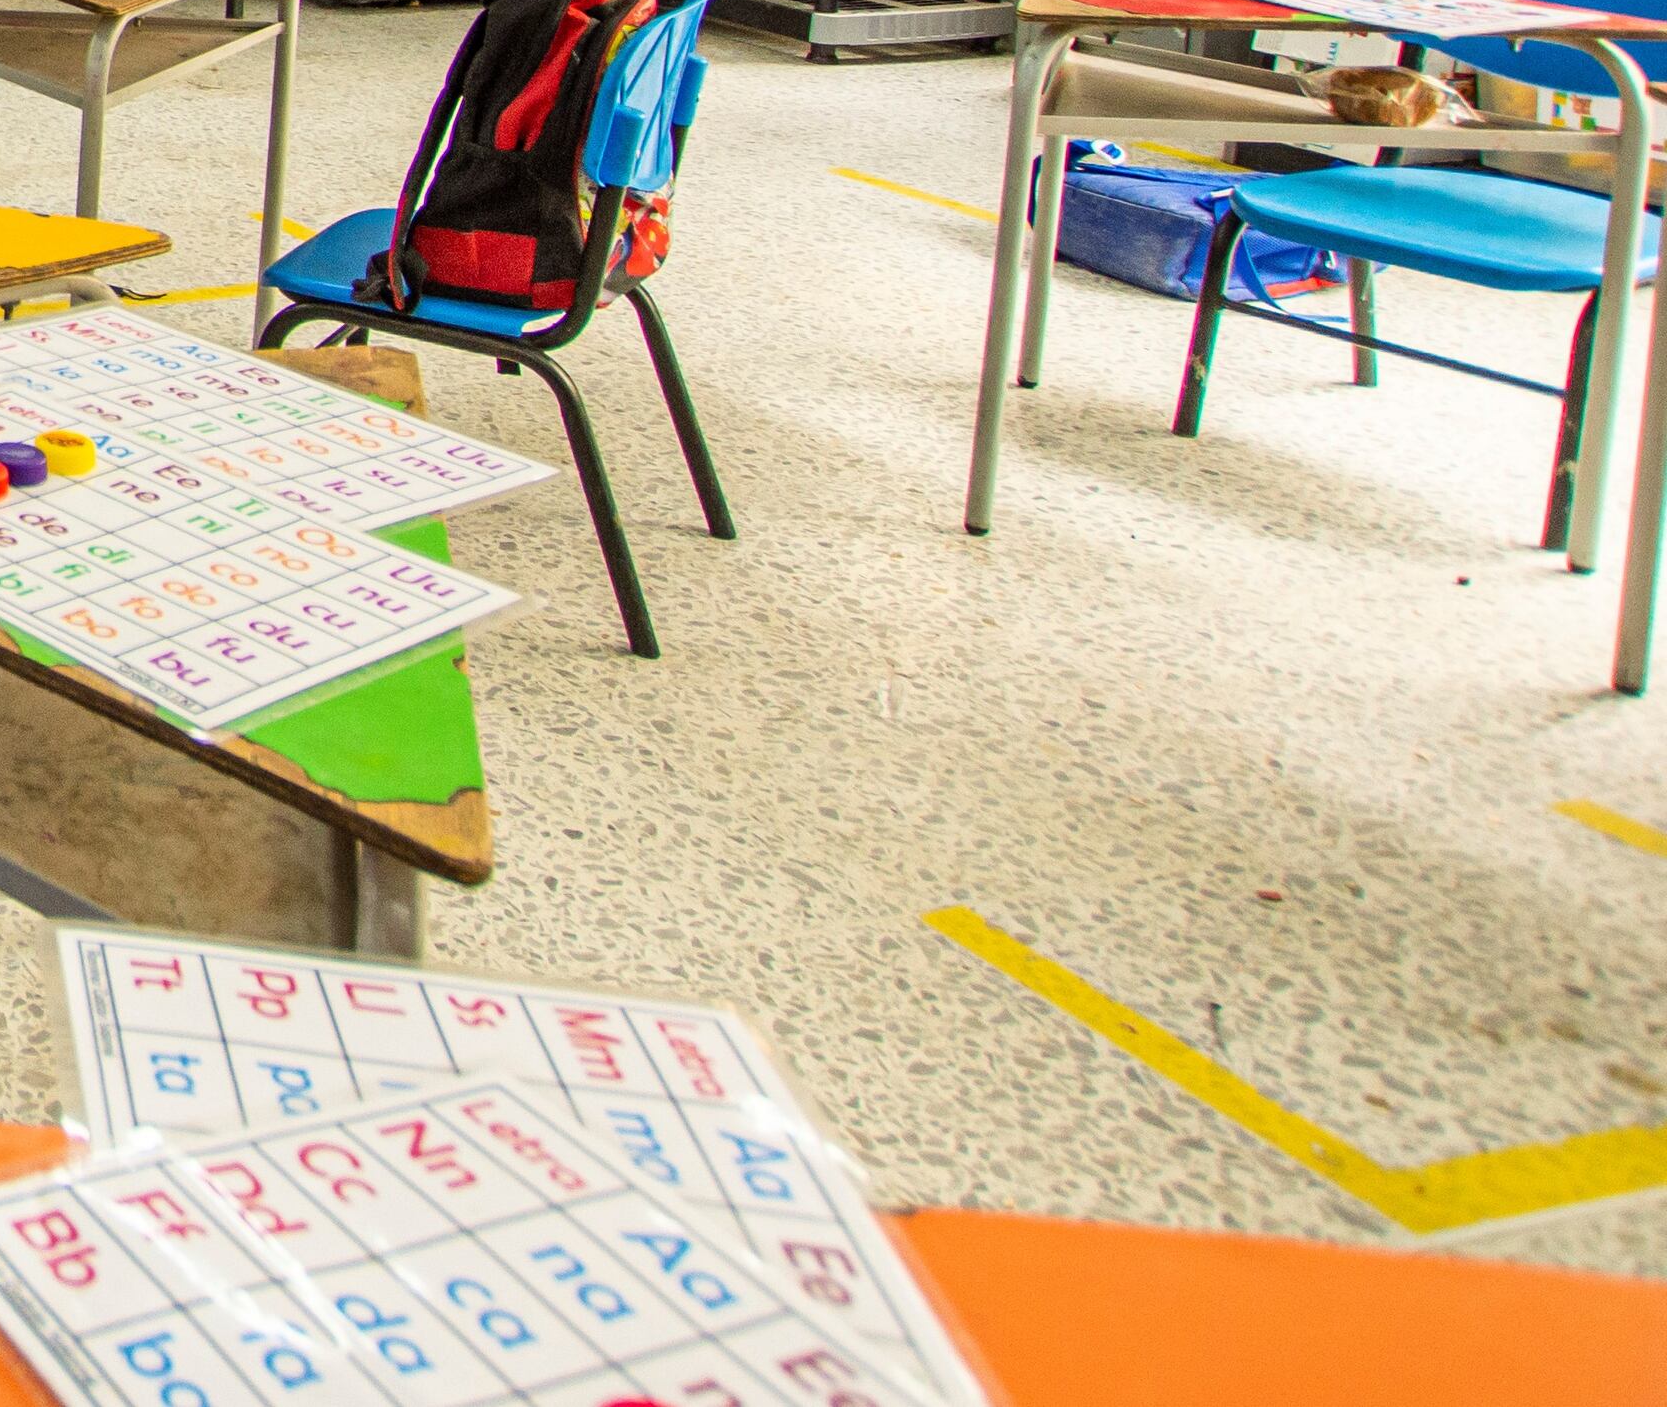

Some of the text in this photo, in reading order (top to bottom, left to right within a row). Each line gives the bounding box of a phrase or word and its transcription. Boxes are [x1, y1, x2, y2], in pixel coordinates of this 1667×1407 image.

[195, 374, 249, 396] me
[153, 464, 202, 490] Ee
[401, 453, 466, 483] mu
[109, 479, 160, 504] ne
[254, 544, 311, 573] no
[296, 528, 356, 558] Oo
[210, 563, 258, 586] co
[389, 565, 457, 599] Uu
[248, 619, 313, 651] du
[149, 651, 211, 688] bu
[131, 958, 183, 991] Tt
[238, 968, 297, 1020] Pp
[461, 1101, 586, 1191] Letra
[13, 1211, 97, 1288] Bb
[529, 1245, 635, 1322] na
[622, 1231, 738, 1311] Aa
[446, 1278, 537, 1349] ca
